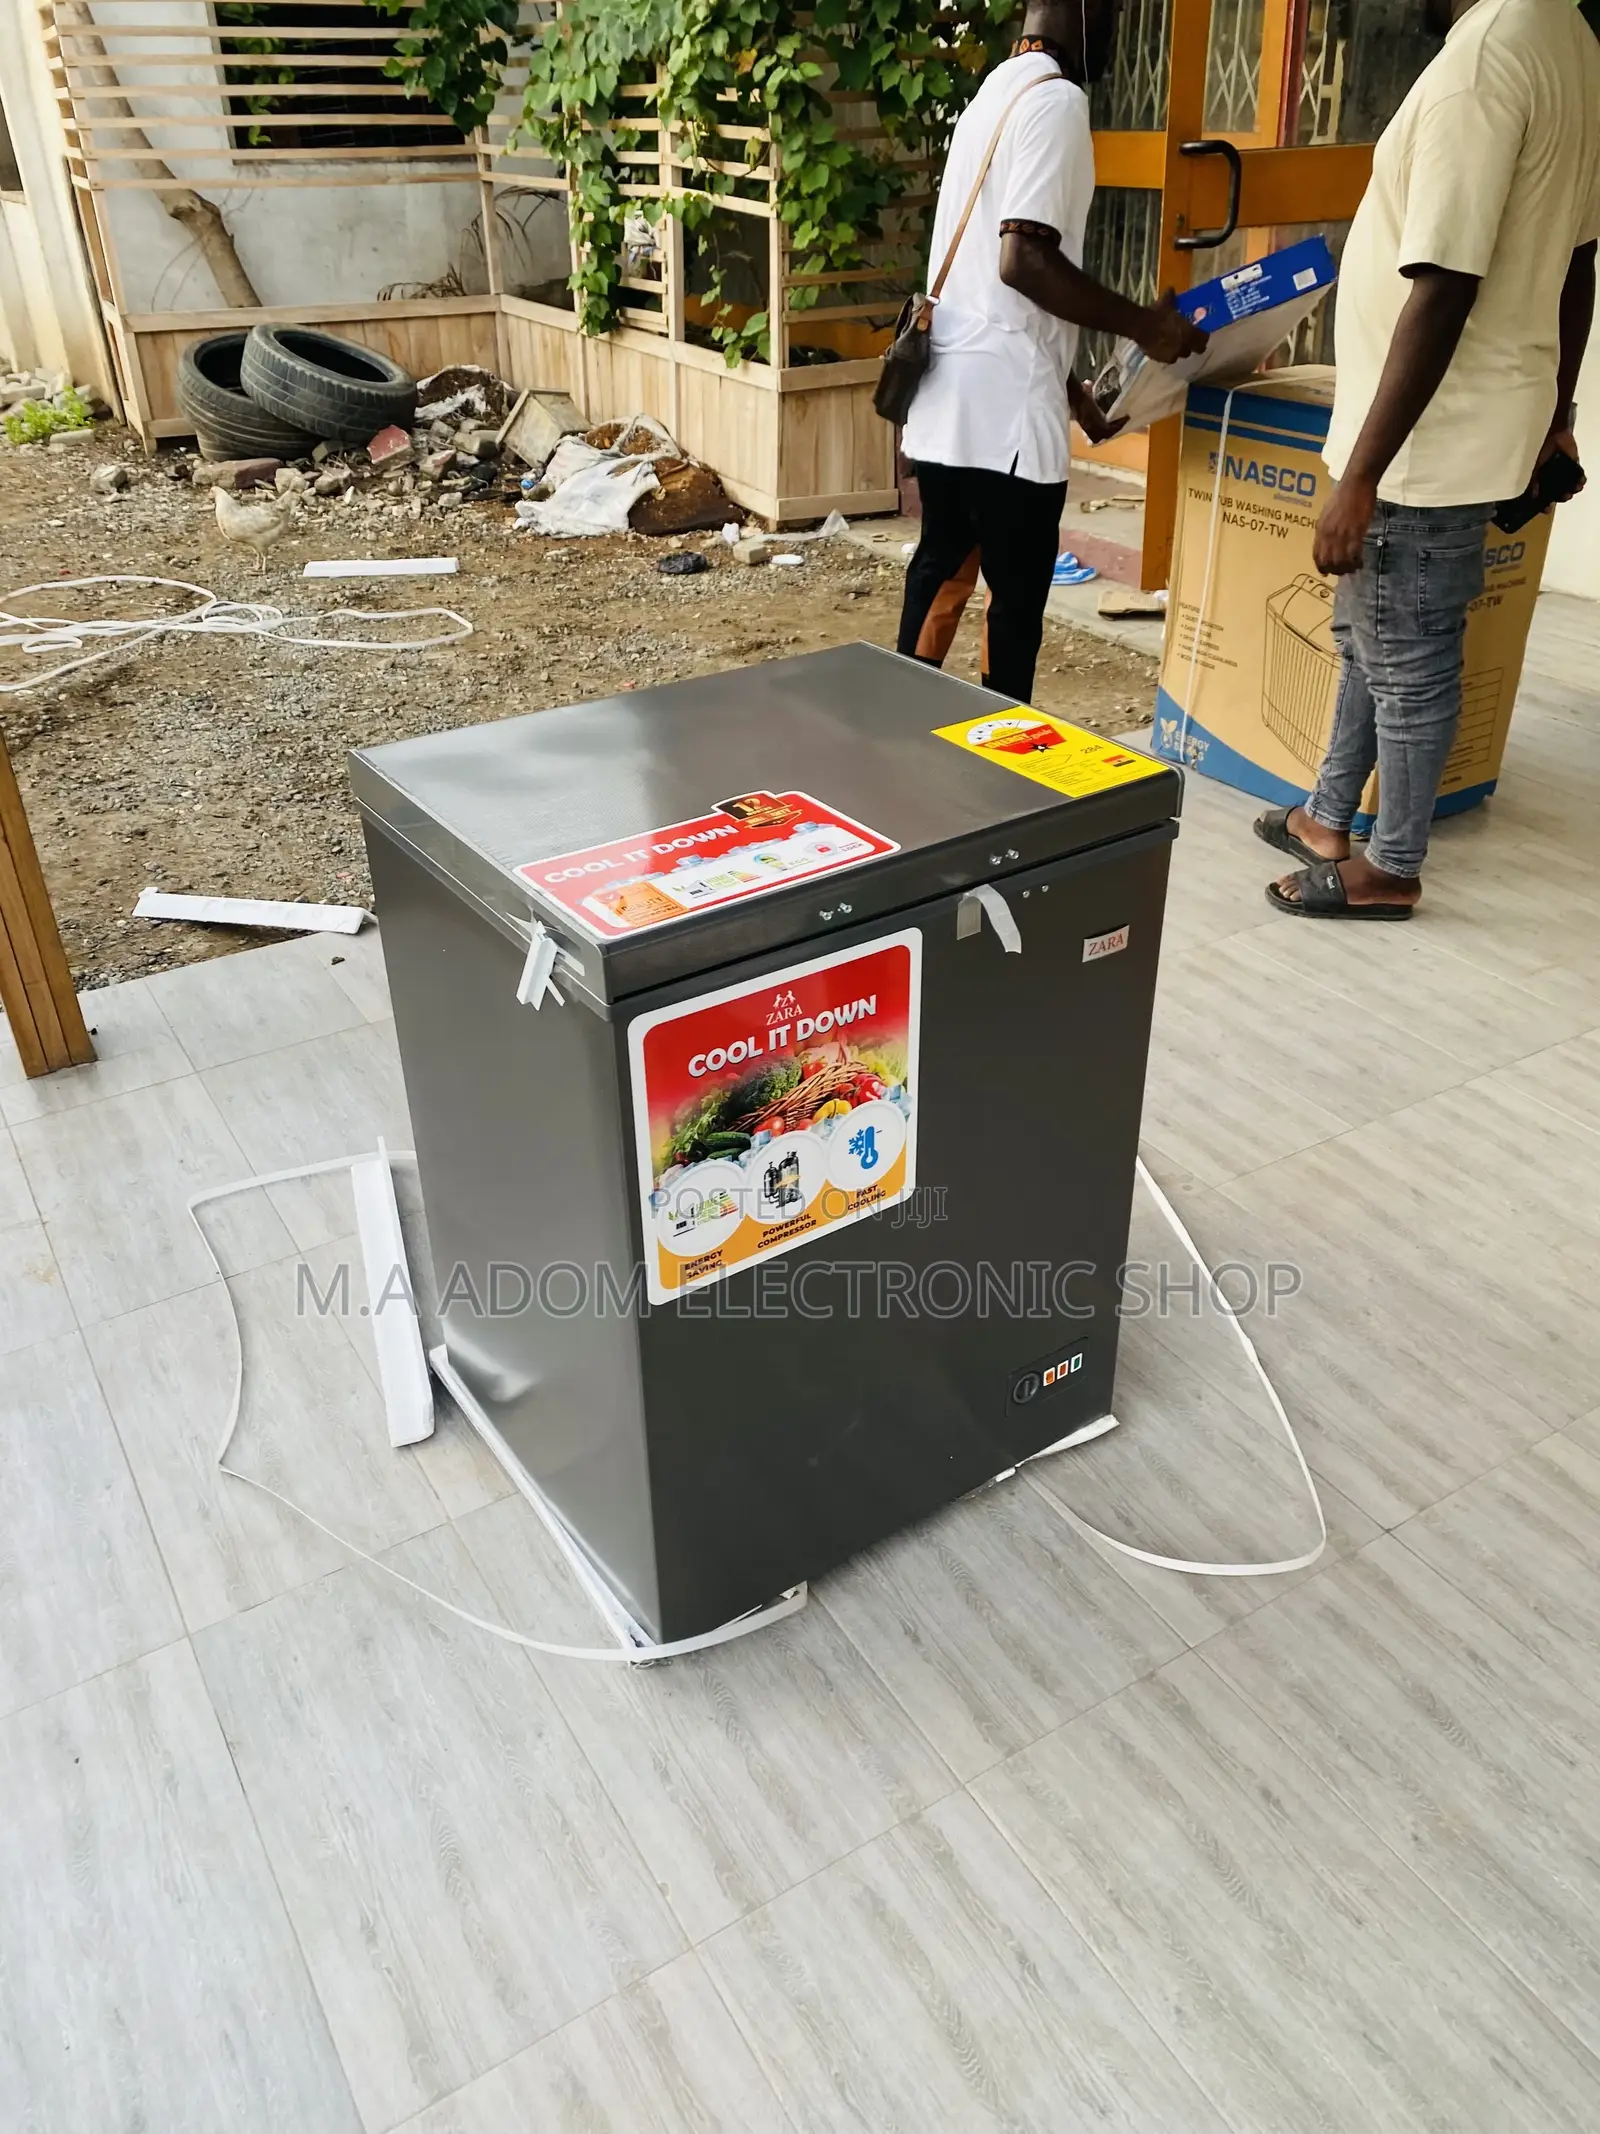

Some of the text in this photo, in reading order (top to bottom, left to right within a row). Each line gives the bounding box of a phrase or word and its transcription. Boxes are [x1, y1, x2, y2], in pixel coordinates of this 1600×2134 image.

[1224, 455, 1317, 497] NASCO
[1188, 488, 1212, 503] TWIN
[1235, 499, 1282, 520] WASHING
[1284, 512, 1318, 530] MACHI
[1222, 511, 1289, 540] NAS-07-TW
[1484, 541, 1526, 567] SCO
[544, 824, 740, 884] COOL IT DOWN
[1088, 932, 1124, 956] ZARA
[766, 1003, 803, 1026] ZARA
[688, 994, 878, 1078] COOL IT DOWN
[847, 1190, 887, 1211] COOLING
[856, 1184, 879, 1199] FAST
[757, 1219, 817, 1249] COMPRESSOR
[762, 1213, 812, 1238] POWERFUL
[684, 1249, 724, 1271] ENERGY
[686, 1259, 723, 1279] SAVING
